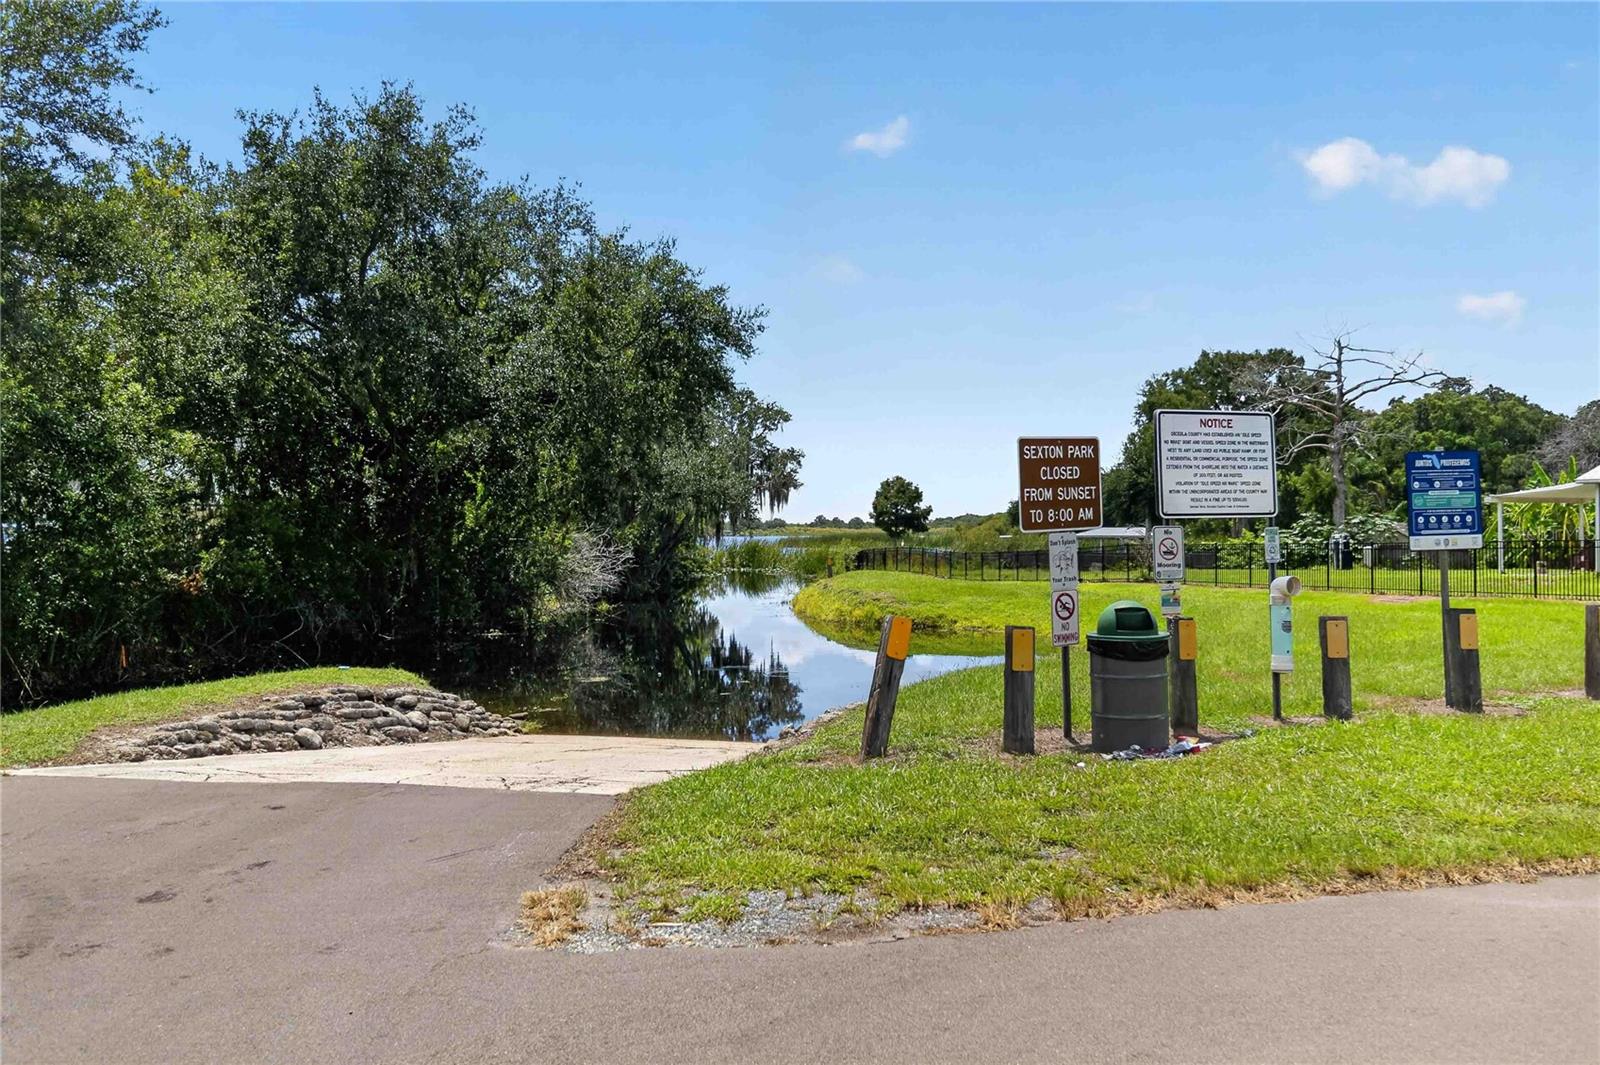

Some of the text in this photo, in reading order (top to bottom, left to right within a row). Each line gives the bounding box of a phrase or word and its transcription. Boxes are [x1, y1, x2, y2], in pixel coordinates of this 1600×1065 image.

[1200, 418, 1233, 429] NOTICE
[1024, 445, 1094, 459] SEXTON PARK
[1440, 458, 1471, 466] PROTEGEMOS
[1040, 466, 1080, 480] CLOSED
[1024, 486, 1096, 502] FROM SUNSET
[1030, 507, 1094, 523] TO 8:00 AM
[1061, 622, 1070, 631] NO
[1054, 632, 1078, 644] SWIMMING
